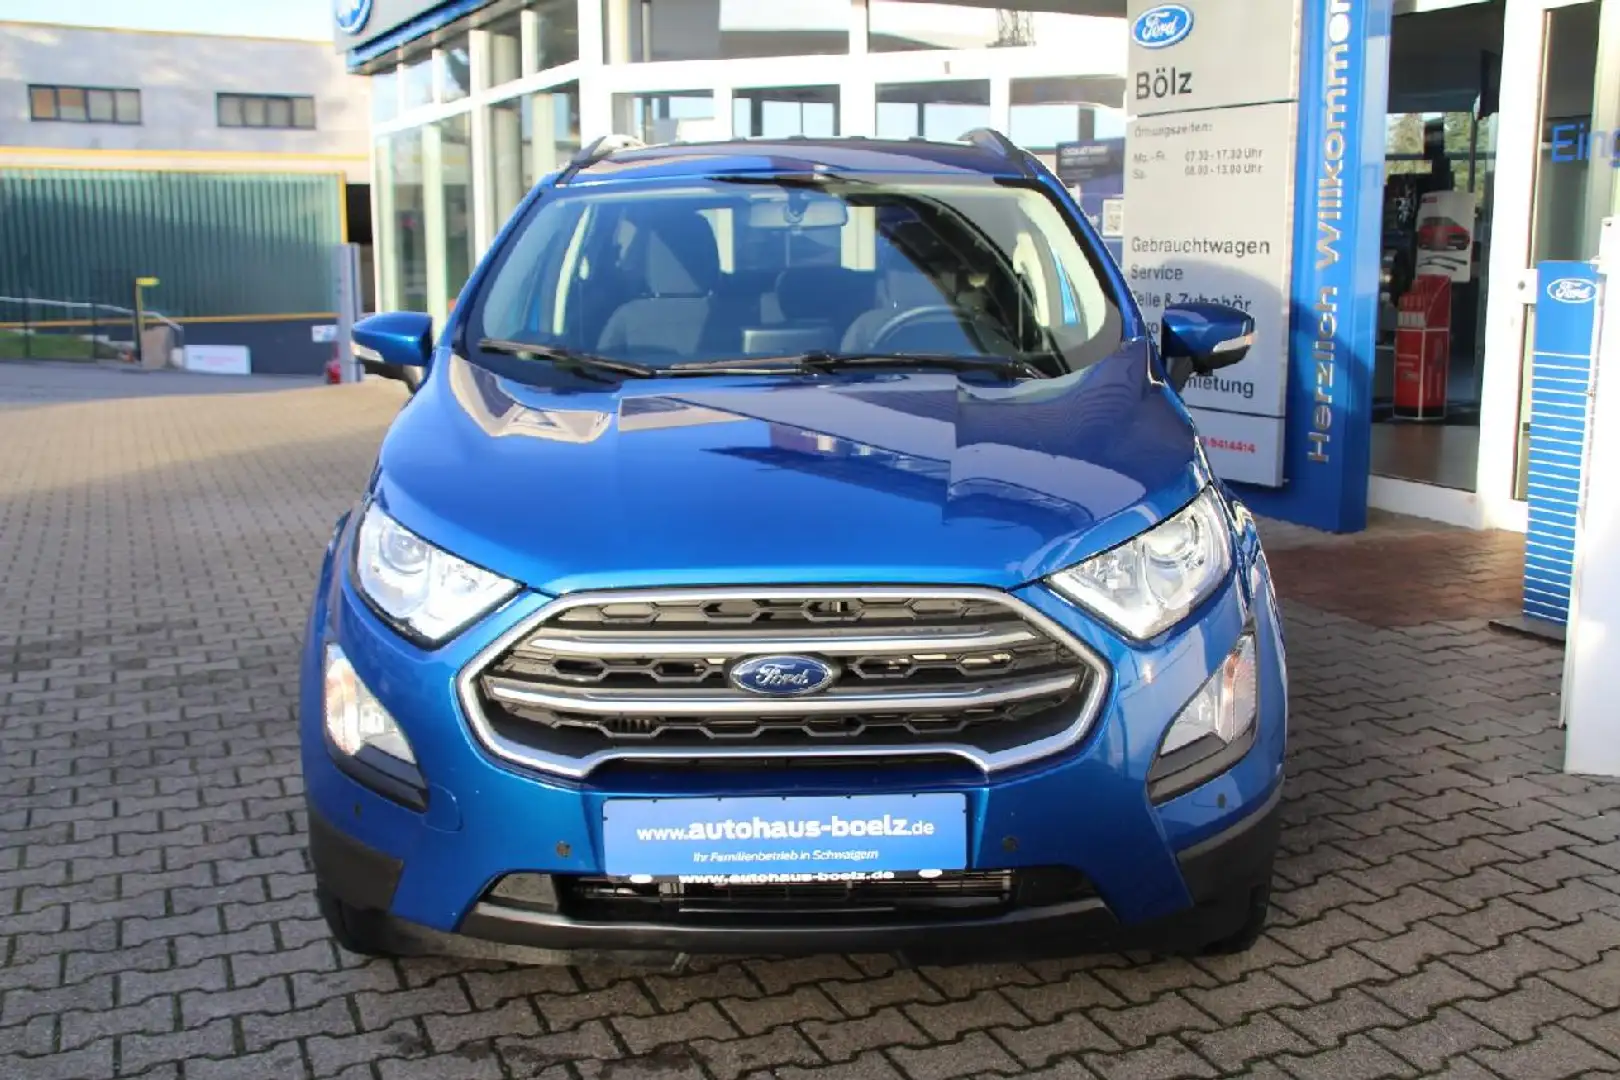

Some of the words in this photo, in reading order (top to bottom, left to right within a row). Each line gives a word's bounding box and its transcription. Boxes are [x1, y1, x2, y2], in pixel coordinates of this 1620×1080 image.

[1142, 12, 1179, 40] Ford
[1136, 66, 1192, 99] Bölz
[1244, 147, 1263, 158] Uhr
[1244, 163, 1263, 174] Uhr
[1131, 236, 1270, 258] Gebrauchtwagen
[1131, 264, 1183, 280] Service
[1556, 280, 1592, 299] Ford
[1307, 286, 1338, 463] Herzlich
[756, 663, 808, 685] Ford
[637, 814, 935, 841] www.autohaus-boelz.de
[693, 852, 708, 862] Ihr
[711, 850, 798, 863] Familienbetrieb
[800, 851, 810, 861] in
